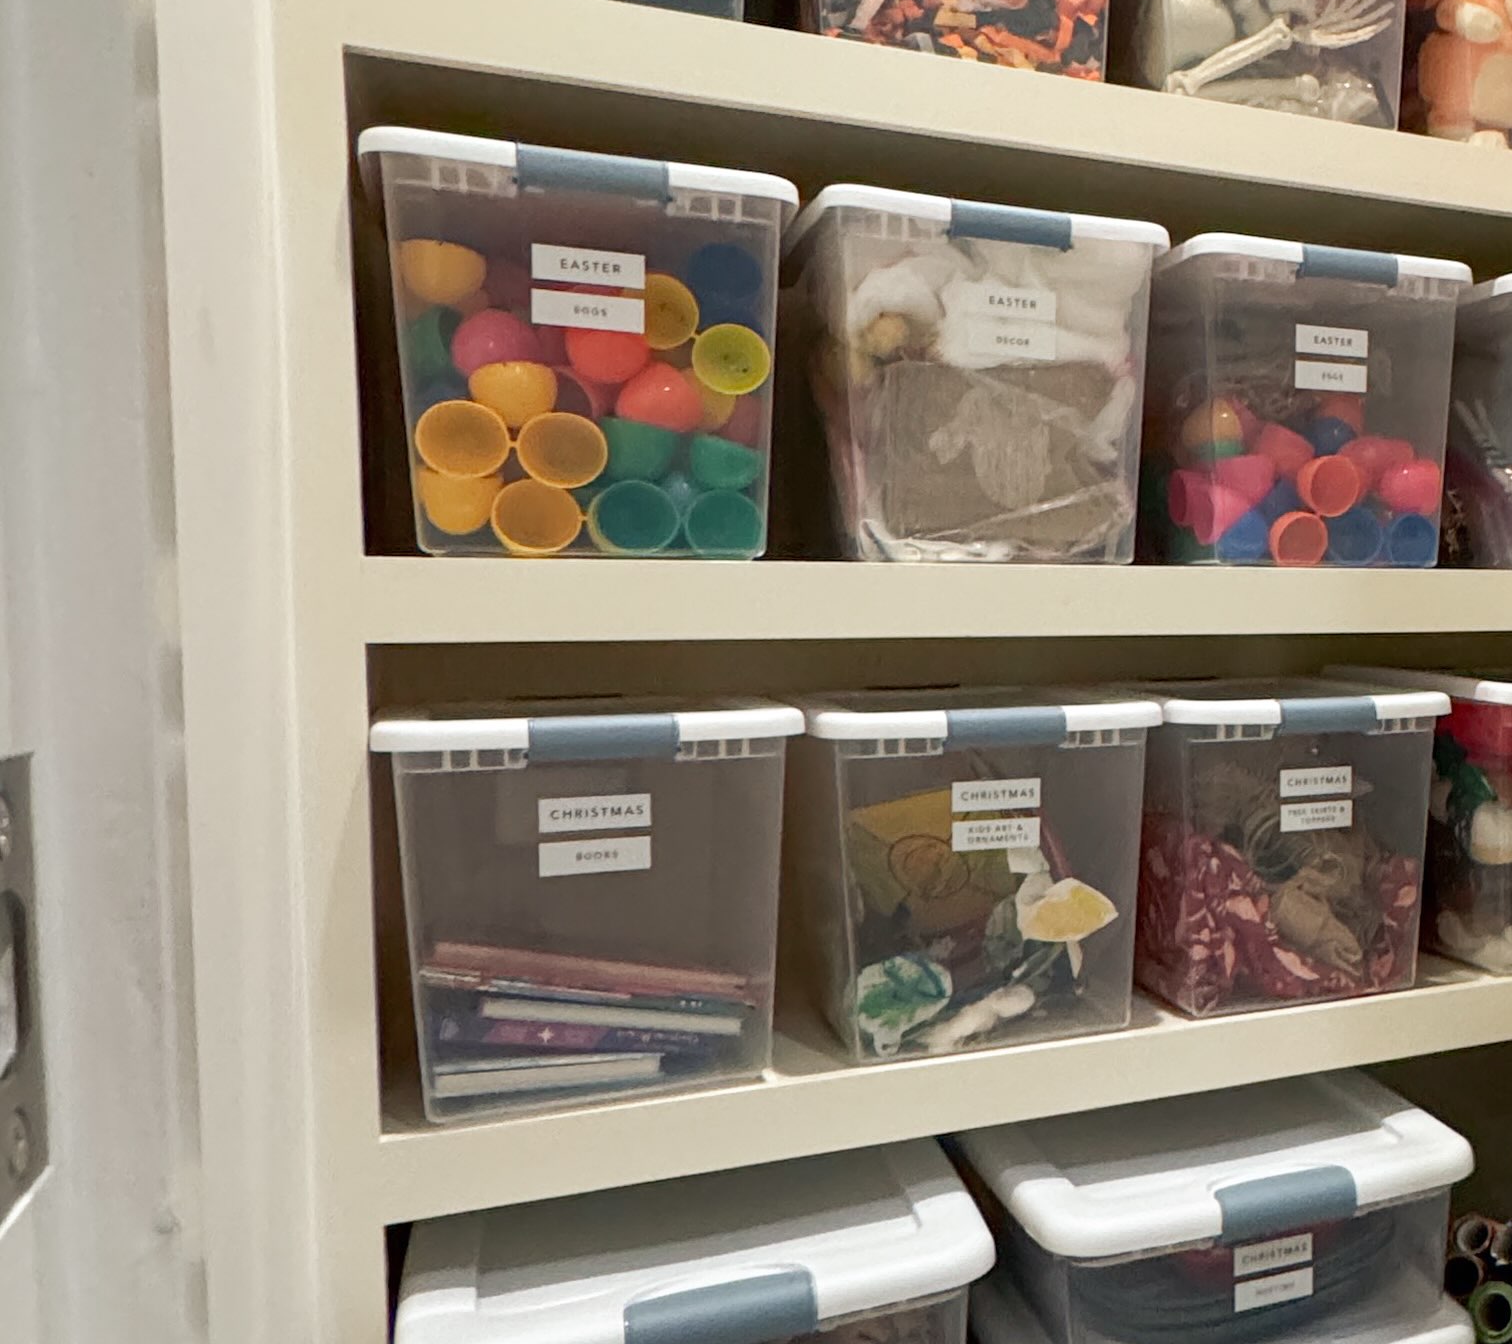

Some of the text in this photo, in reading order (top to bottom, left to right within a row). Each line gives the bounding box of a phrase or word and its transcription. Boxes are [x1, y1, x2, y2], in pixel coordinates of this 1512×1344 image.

[559, 258, 622, 275] EASTER
[988, 294, 1038, 311] EASTER
[573, 306, 608, 318] EGGS
[995, 335, 1031, 348] DECOR
[1312, 334, 1353, 349] EASTER
[1286, 774, 1348, 788] CHRISTMAS
[959, 787, 1036, 803] CHRISTMAS
[549, 804, 645, 822] CHRISTMAS
[967, 825, 991, 834] KIDS
[994, 824, 1013, 832] ART
[967, 833, 1029, 845] ORNAMENTS
[574, 849, 619, 863] BOOKS
[1241, 1241, 1309, 1266] CHRISTMAS
